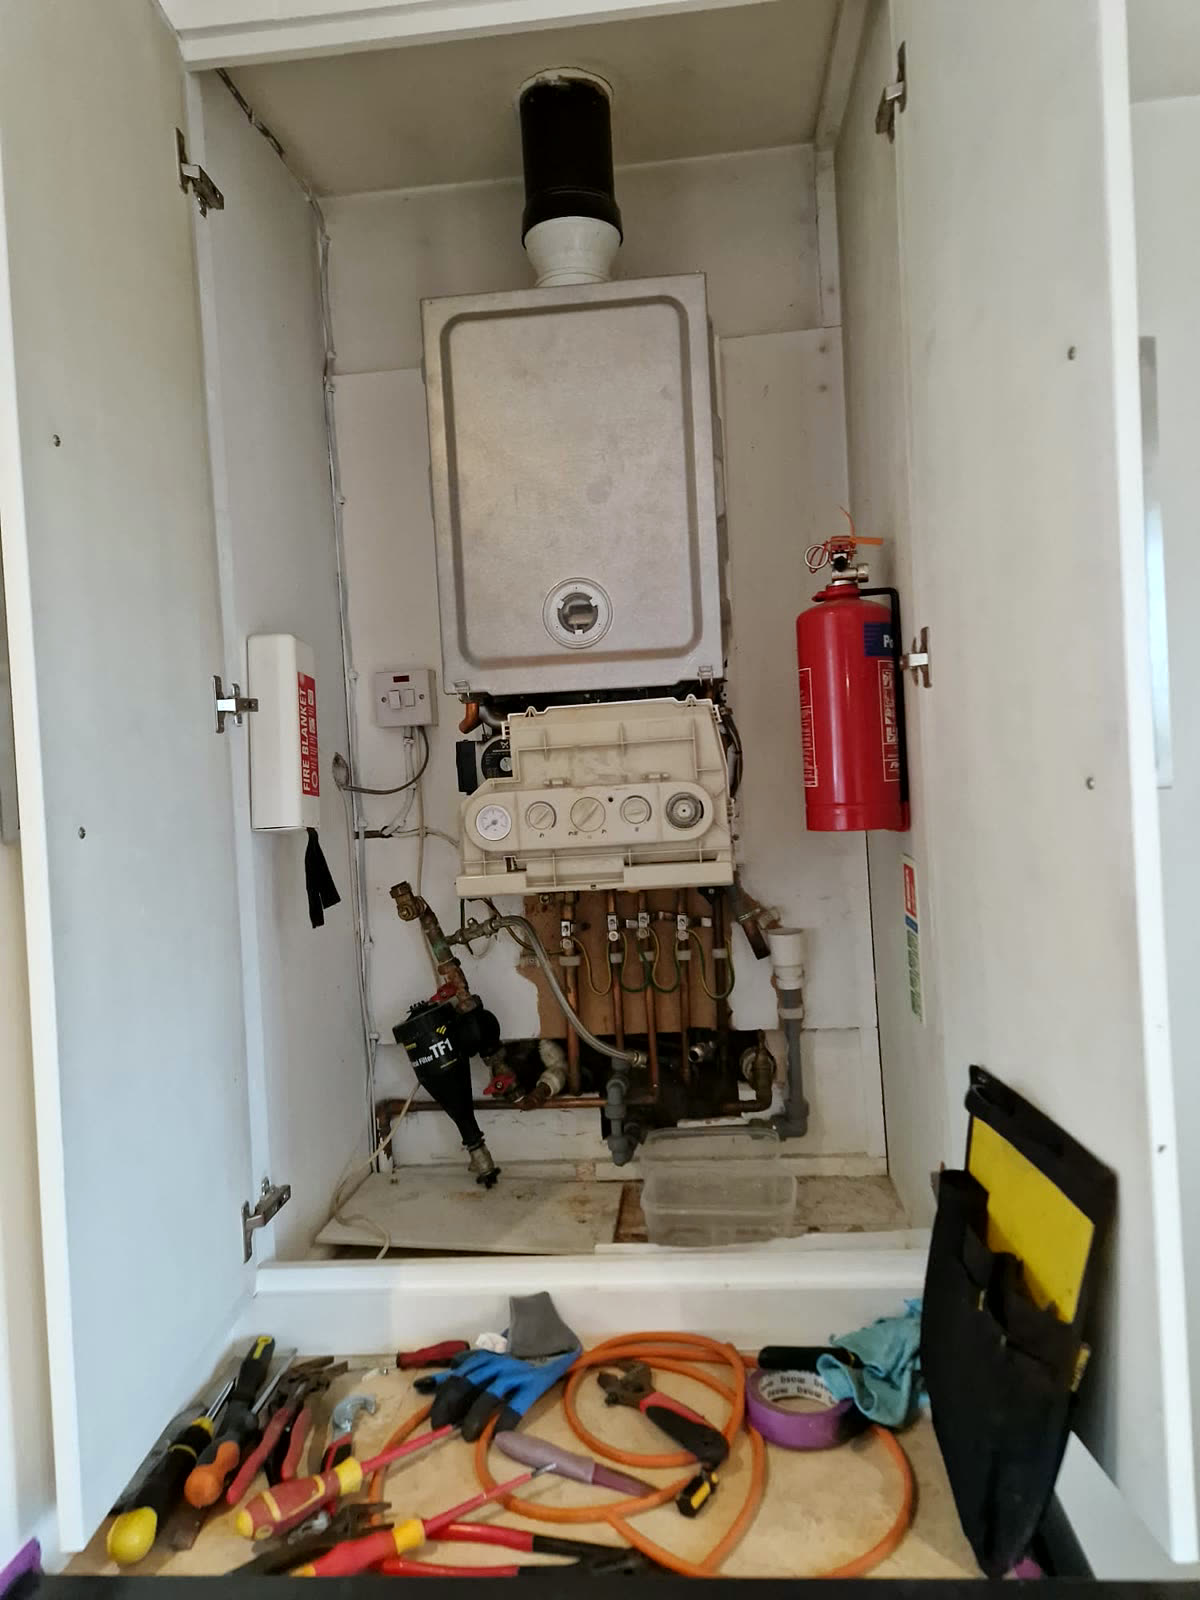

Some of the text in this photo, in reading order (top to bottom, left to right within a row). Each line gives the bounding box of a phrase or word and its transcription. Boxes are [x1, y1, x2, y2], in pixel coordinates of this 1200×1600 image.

[300, 688, 311, 792] FIRE BLANKET
[418, 1054, 433, 1065] Filter
[429, 1038, 453, 1058] TF1
